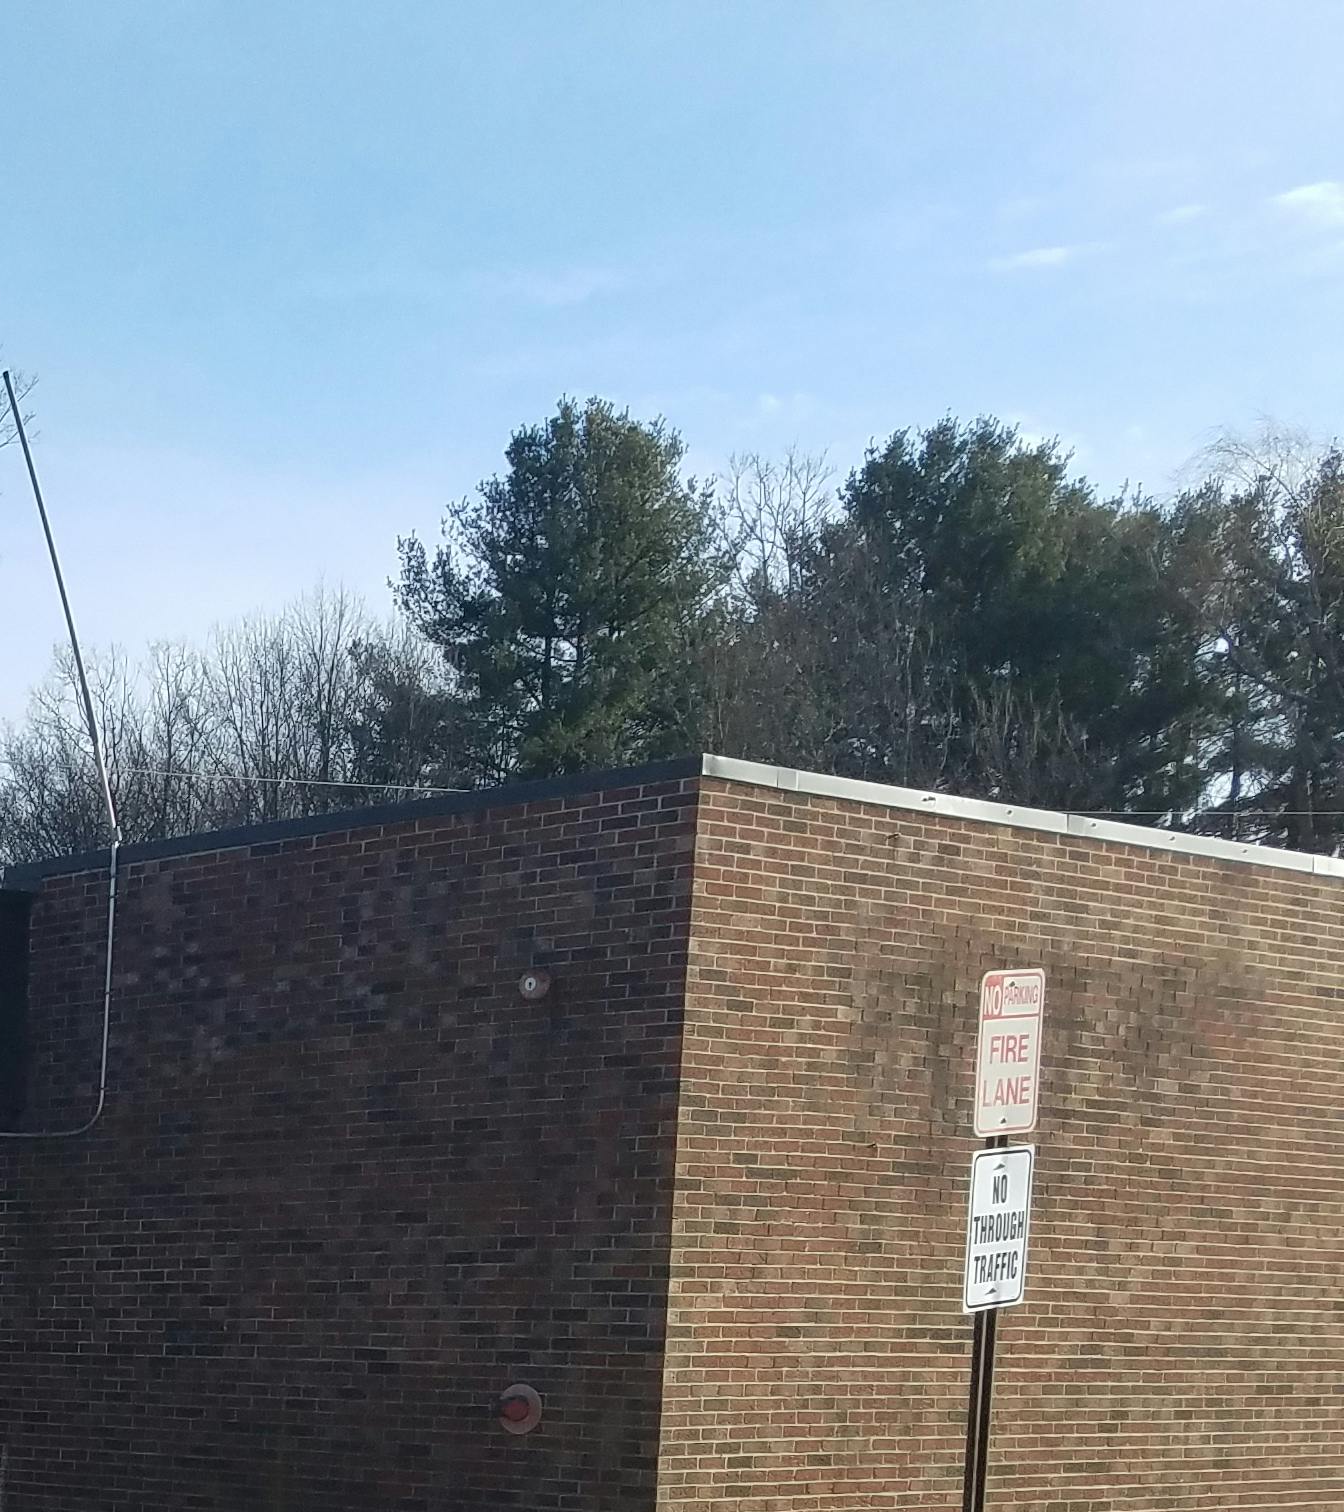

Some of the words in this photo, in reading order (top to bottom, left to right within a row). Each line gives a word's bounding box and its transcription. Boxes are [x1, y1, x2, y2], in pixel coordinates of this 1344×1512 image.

[984, 984, 1002, 1017] NO
[1003, 984, 1039, 1006] PARKING
[989, 1034, 1030, 1065] FIRE
[983, 1076, 1032, 1107] LANE
[992, 1173, 1007, 1204] NO
[974, 1210, 1024, 1245] THROUGH
[974, 1252, 1018, 1284] TRAFFIC
